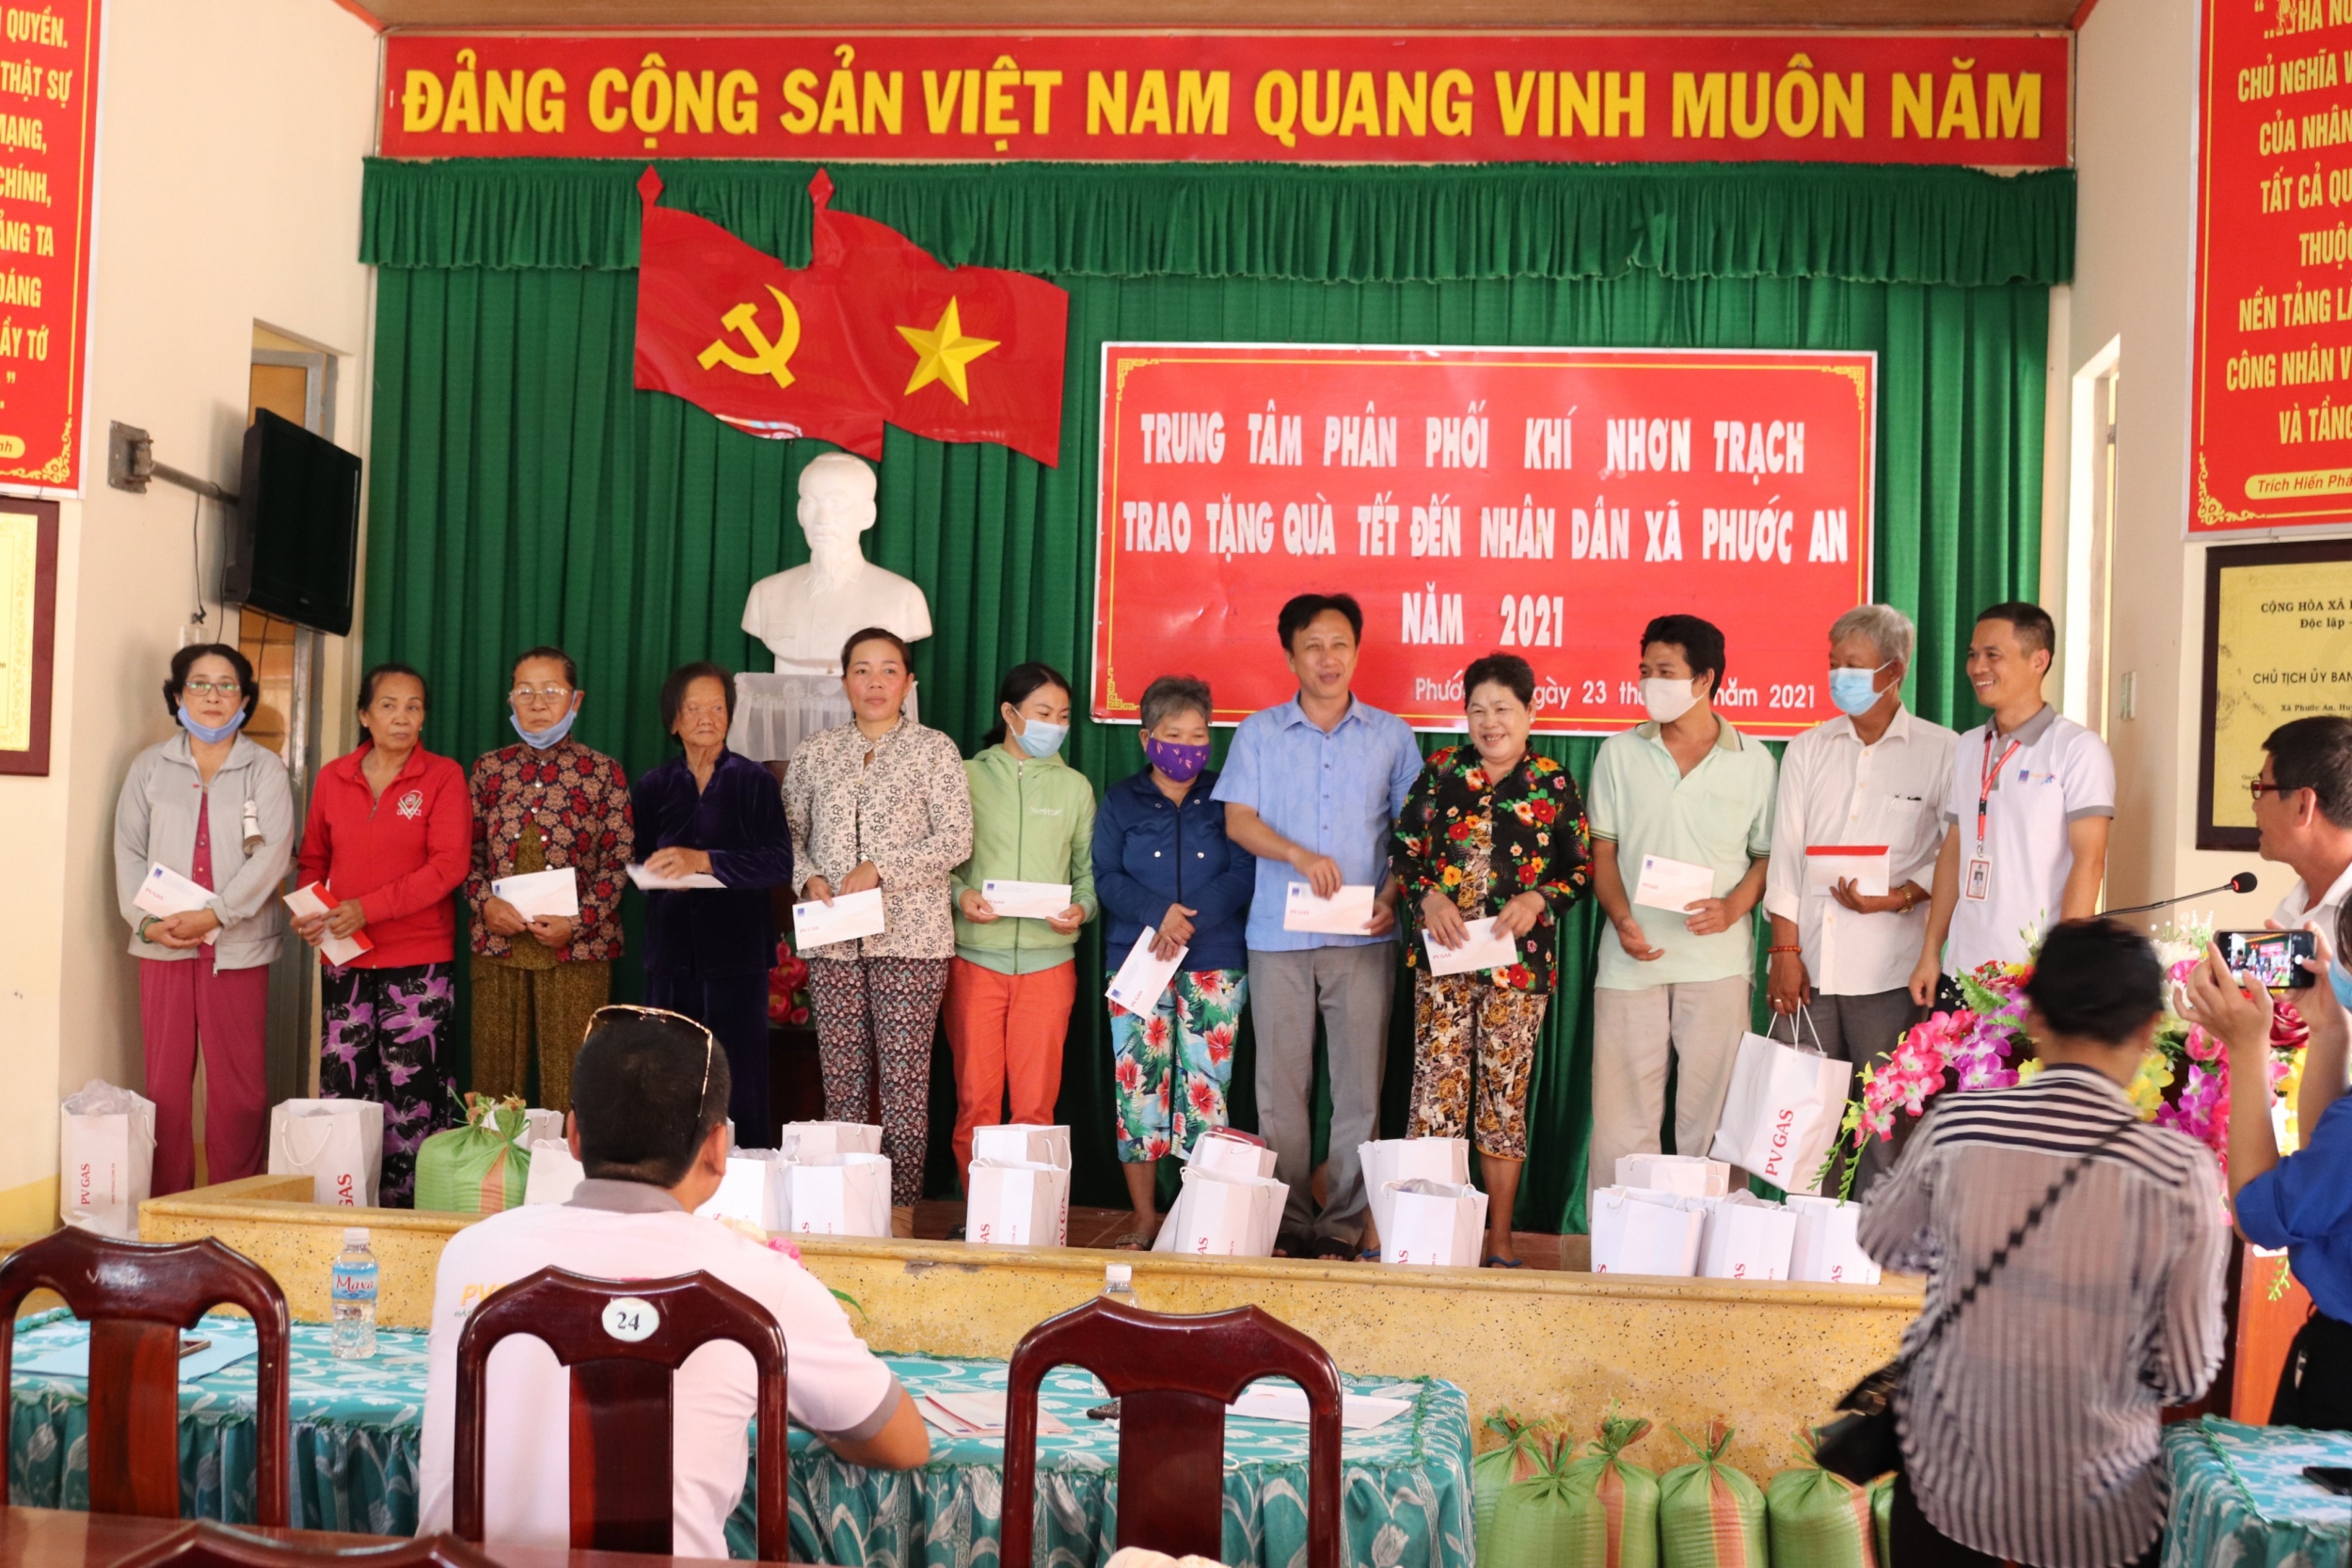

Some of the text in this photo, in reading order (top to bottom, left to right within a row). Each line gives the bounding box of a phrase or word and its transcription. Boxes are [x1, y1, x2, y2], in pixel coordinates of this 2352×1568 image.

[7, 6, 69, 48] QUYỀN.
[0, 58, 73, 108] THẬT SỰ
[2238, 53, 2275, 103] CHỦ
[2280, 48, 2338, 95] NGHĨA
[402, 45, 2041, 151] ĐẢNG CỘNG SẢN VIỆT NAM QUANG VINH MUÔN NĂM
[2259, 104, 2352, 157] CỦA NHÂN
[2260, 166, 2294, 214] TẤT
[2297, 161, 2324, 209] CẢ
[35, 225, 55, 257] TA
[2239, 285, 2278, 332] NỀN
[2282, 280, 2331, 327] TẢNG
[27, 325, 49, 361] TỚ
[2226, 349, 2277, 391] CÔNG
[2281, 341, 2335, 387] NHÂN
[1140, 399, 1806, 484] TRUNG TÂM PHÂN PHỐI KHÍ NHƠN TRẠCH
[2279, 403, 2303, 445] VÀ
[2258, 478, 2290, 494] Trích
[2294, 474, 2324, 491] Hiến
[1123, 491, 1850, 566] TRAO TẶNG QUÀ TẾT ĐẾN NHÂN DÂN XÃ PHƯỚC AN
[1402, 581, 1565, 649] NĂM 2021
[2261, 600, 2295, 615] CỘNG
[2300, 618, 2323, 630] Độc
[1416, 671, 1468, 703] Phướ
[1534, 677, 1572, 711] gày
[1582, 681, 1608, 705] 23
[1770, 685, 1816, 710] 2021
[2253, 669, 2278, 684] CHỦ
[2281, 673, 2307, 686] TỊCH
[2311, 668, 2328, 683] ỦY
[1765, 1109, 1794, 1177] PV GAS
[81, 1163, 90, 1205] PV GAS
[979, 1224, 991, 1244] AS
[460, 1282, 510, 1307] PV
[1831, 1265, 1843, 1283] AS
[616, 1311, 640, 1331] 24
